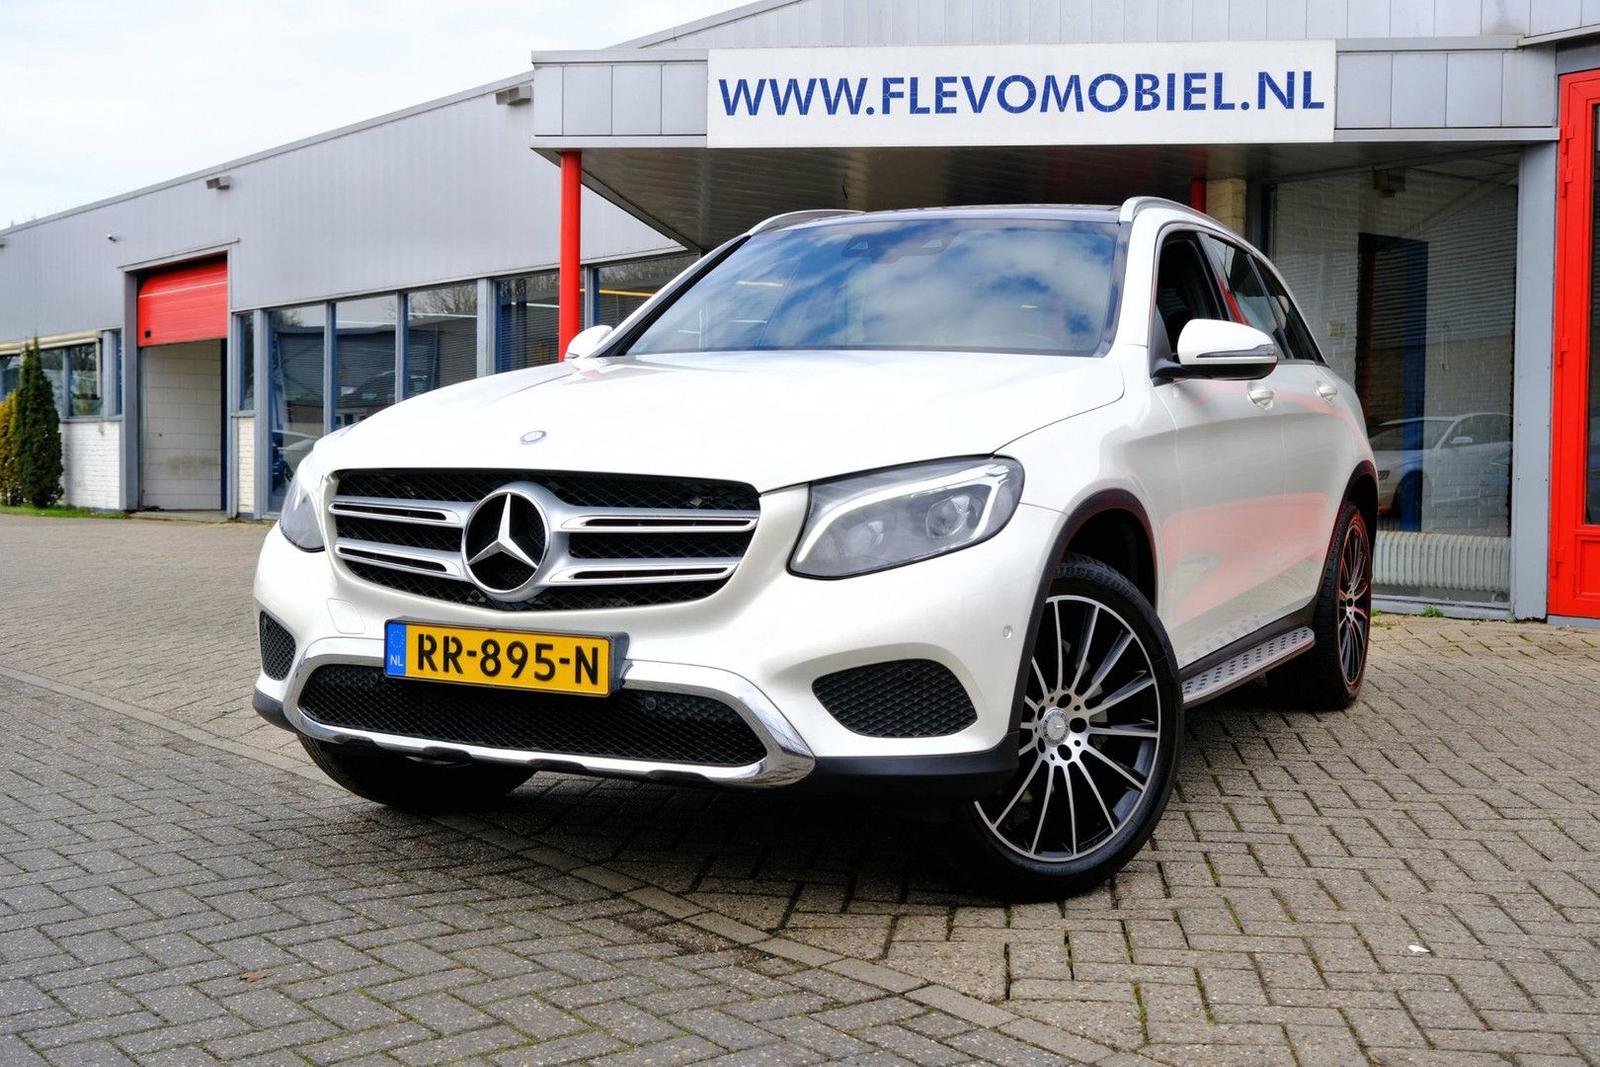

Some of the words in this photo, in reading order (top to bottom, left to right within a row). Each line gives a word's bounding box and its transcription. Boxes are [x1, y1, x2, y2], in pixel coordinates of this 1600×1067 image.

[718, 71, 1325, 116] WWW.FLEVOMOBIEL.NL
[389, 654, 404, 666] NL
[417, 633, 599, 685] RR-895-N
